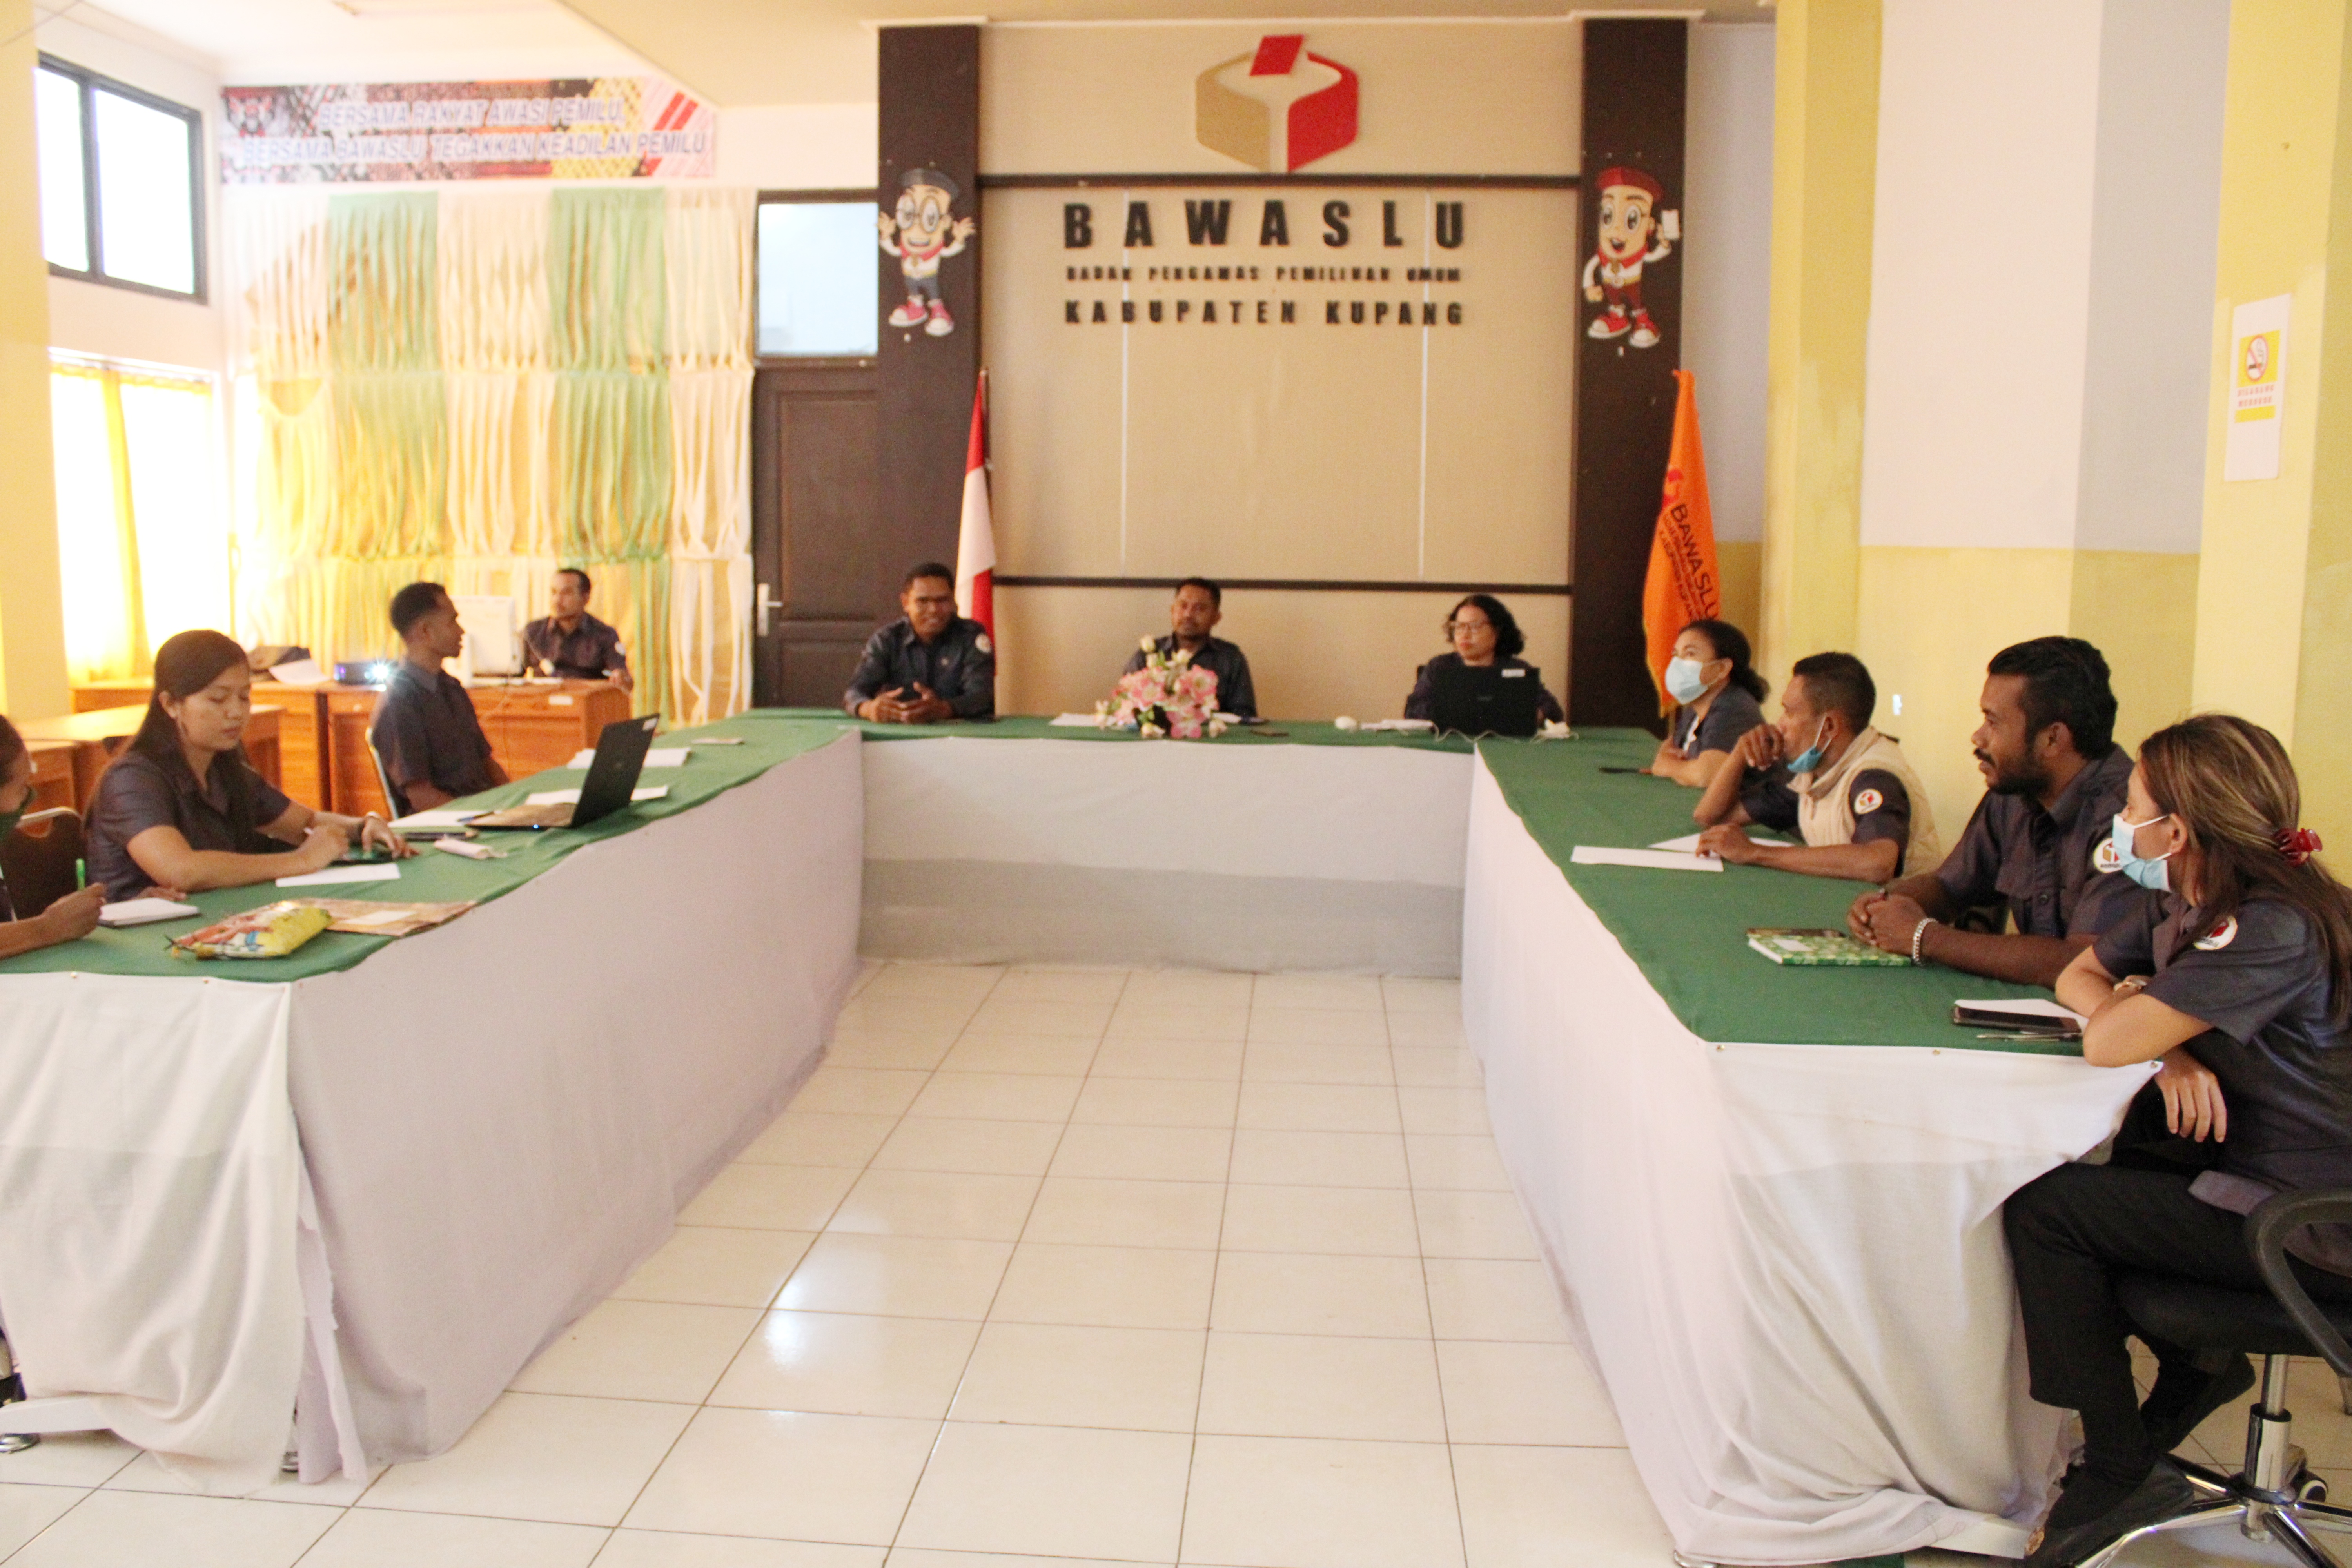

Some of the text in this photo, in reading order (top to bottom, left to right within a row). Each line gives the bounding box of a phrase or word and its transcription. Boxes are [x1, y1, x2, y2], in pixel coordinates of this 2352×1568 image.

[336, 136, 426, 160] BAWASLU
[432, 133, 535, 158] TEGAKKAN
[538, 132, 631, 156] KEADILAN
[637, 132, 706, 154] PEMILU
[1064, 199, 1465, 249] BAWASLU
[1065, 299, 1461, 325] KABUPATEN KUPANG
[1671, 503, 1718, 618] BAWASLU
